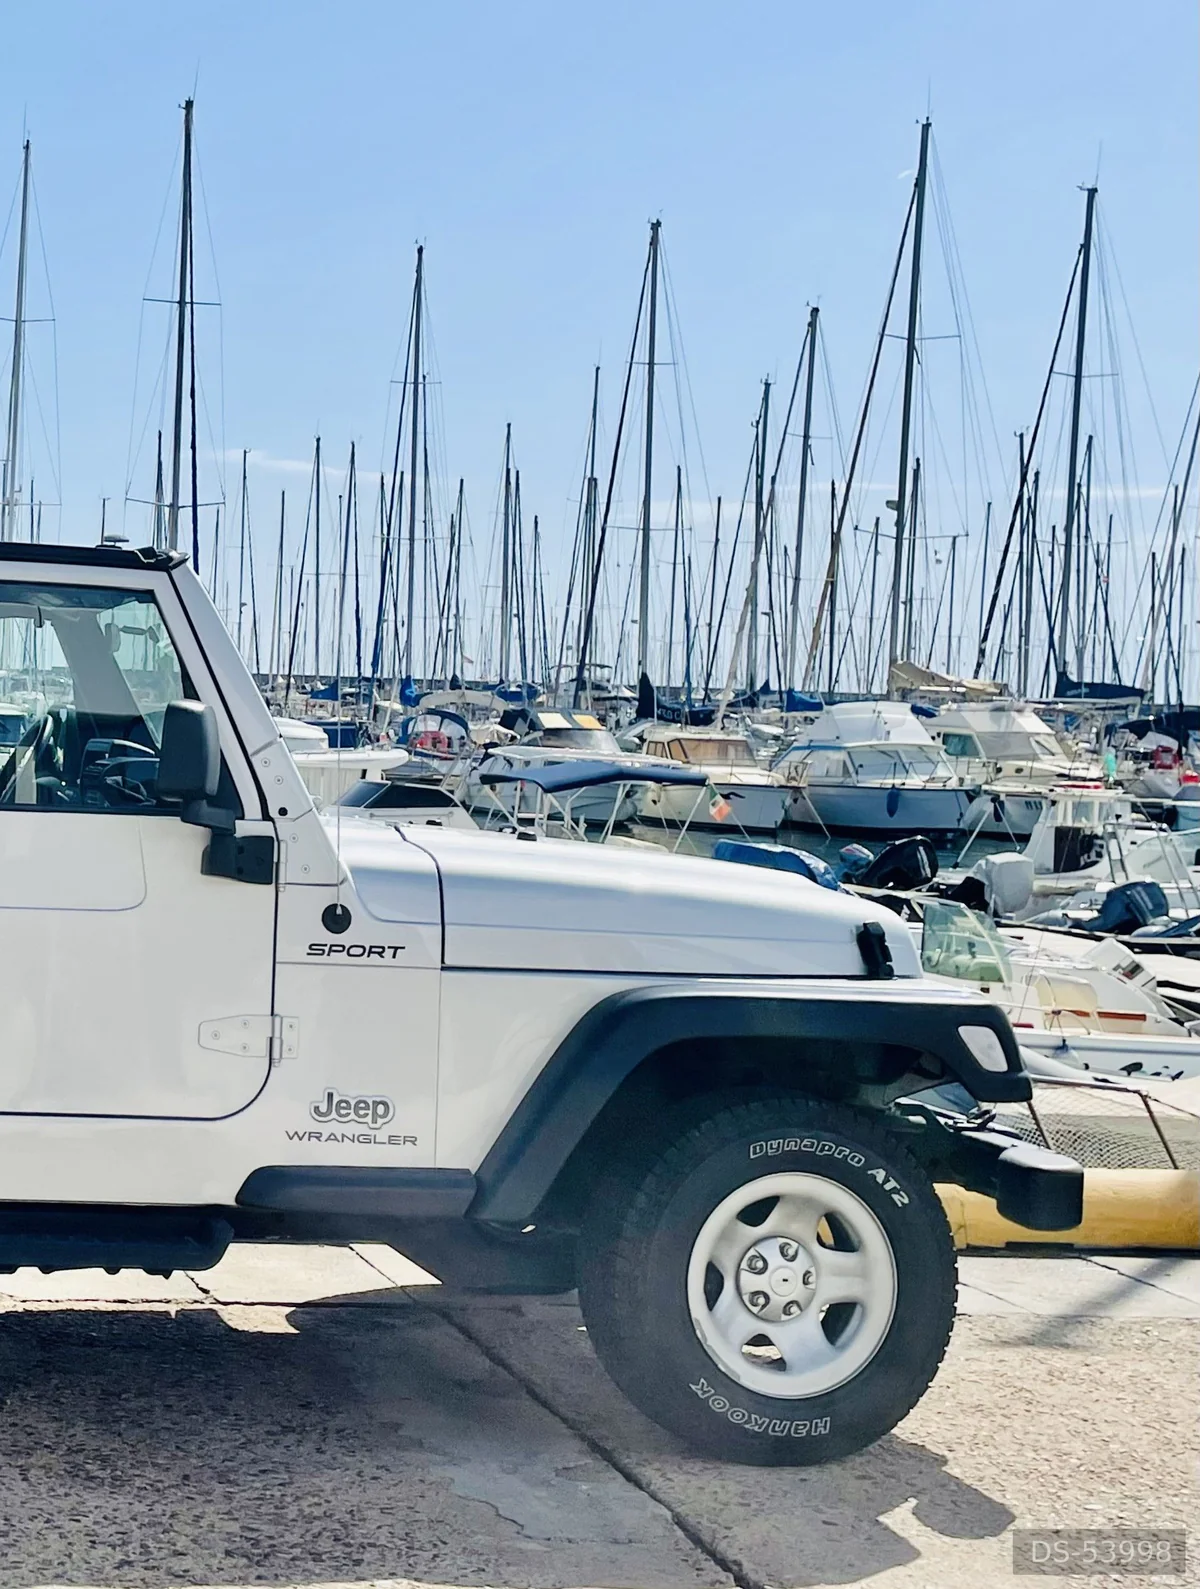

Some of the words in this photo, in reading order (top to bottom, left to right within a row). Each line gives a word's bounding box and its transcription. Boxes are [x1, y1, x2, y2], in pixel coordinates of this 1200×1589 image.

[306, 943, 406, 959] SPORT
[312, 1090, 391, 1125] Jeep
[284, 1130, 418, 1146] WRANGLER
[749, 1138, 866, 1168] Dynapro
[867, 1168, 910, 1208] AT2
